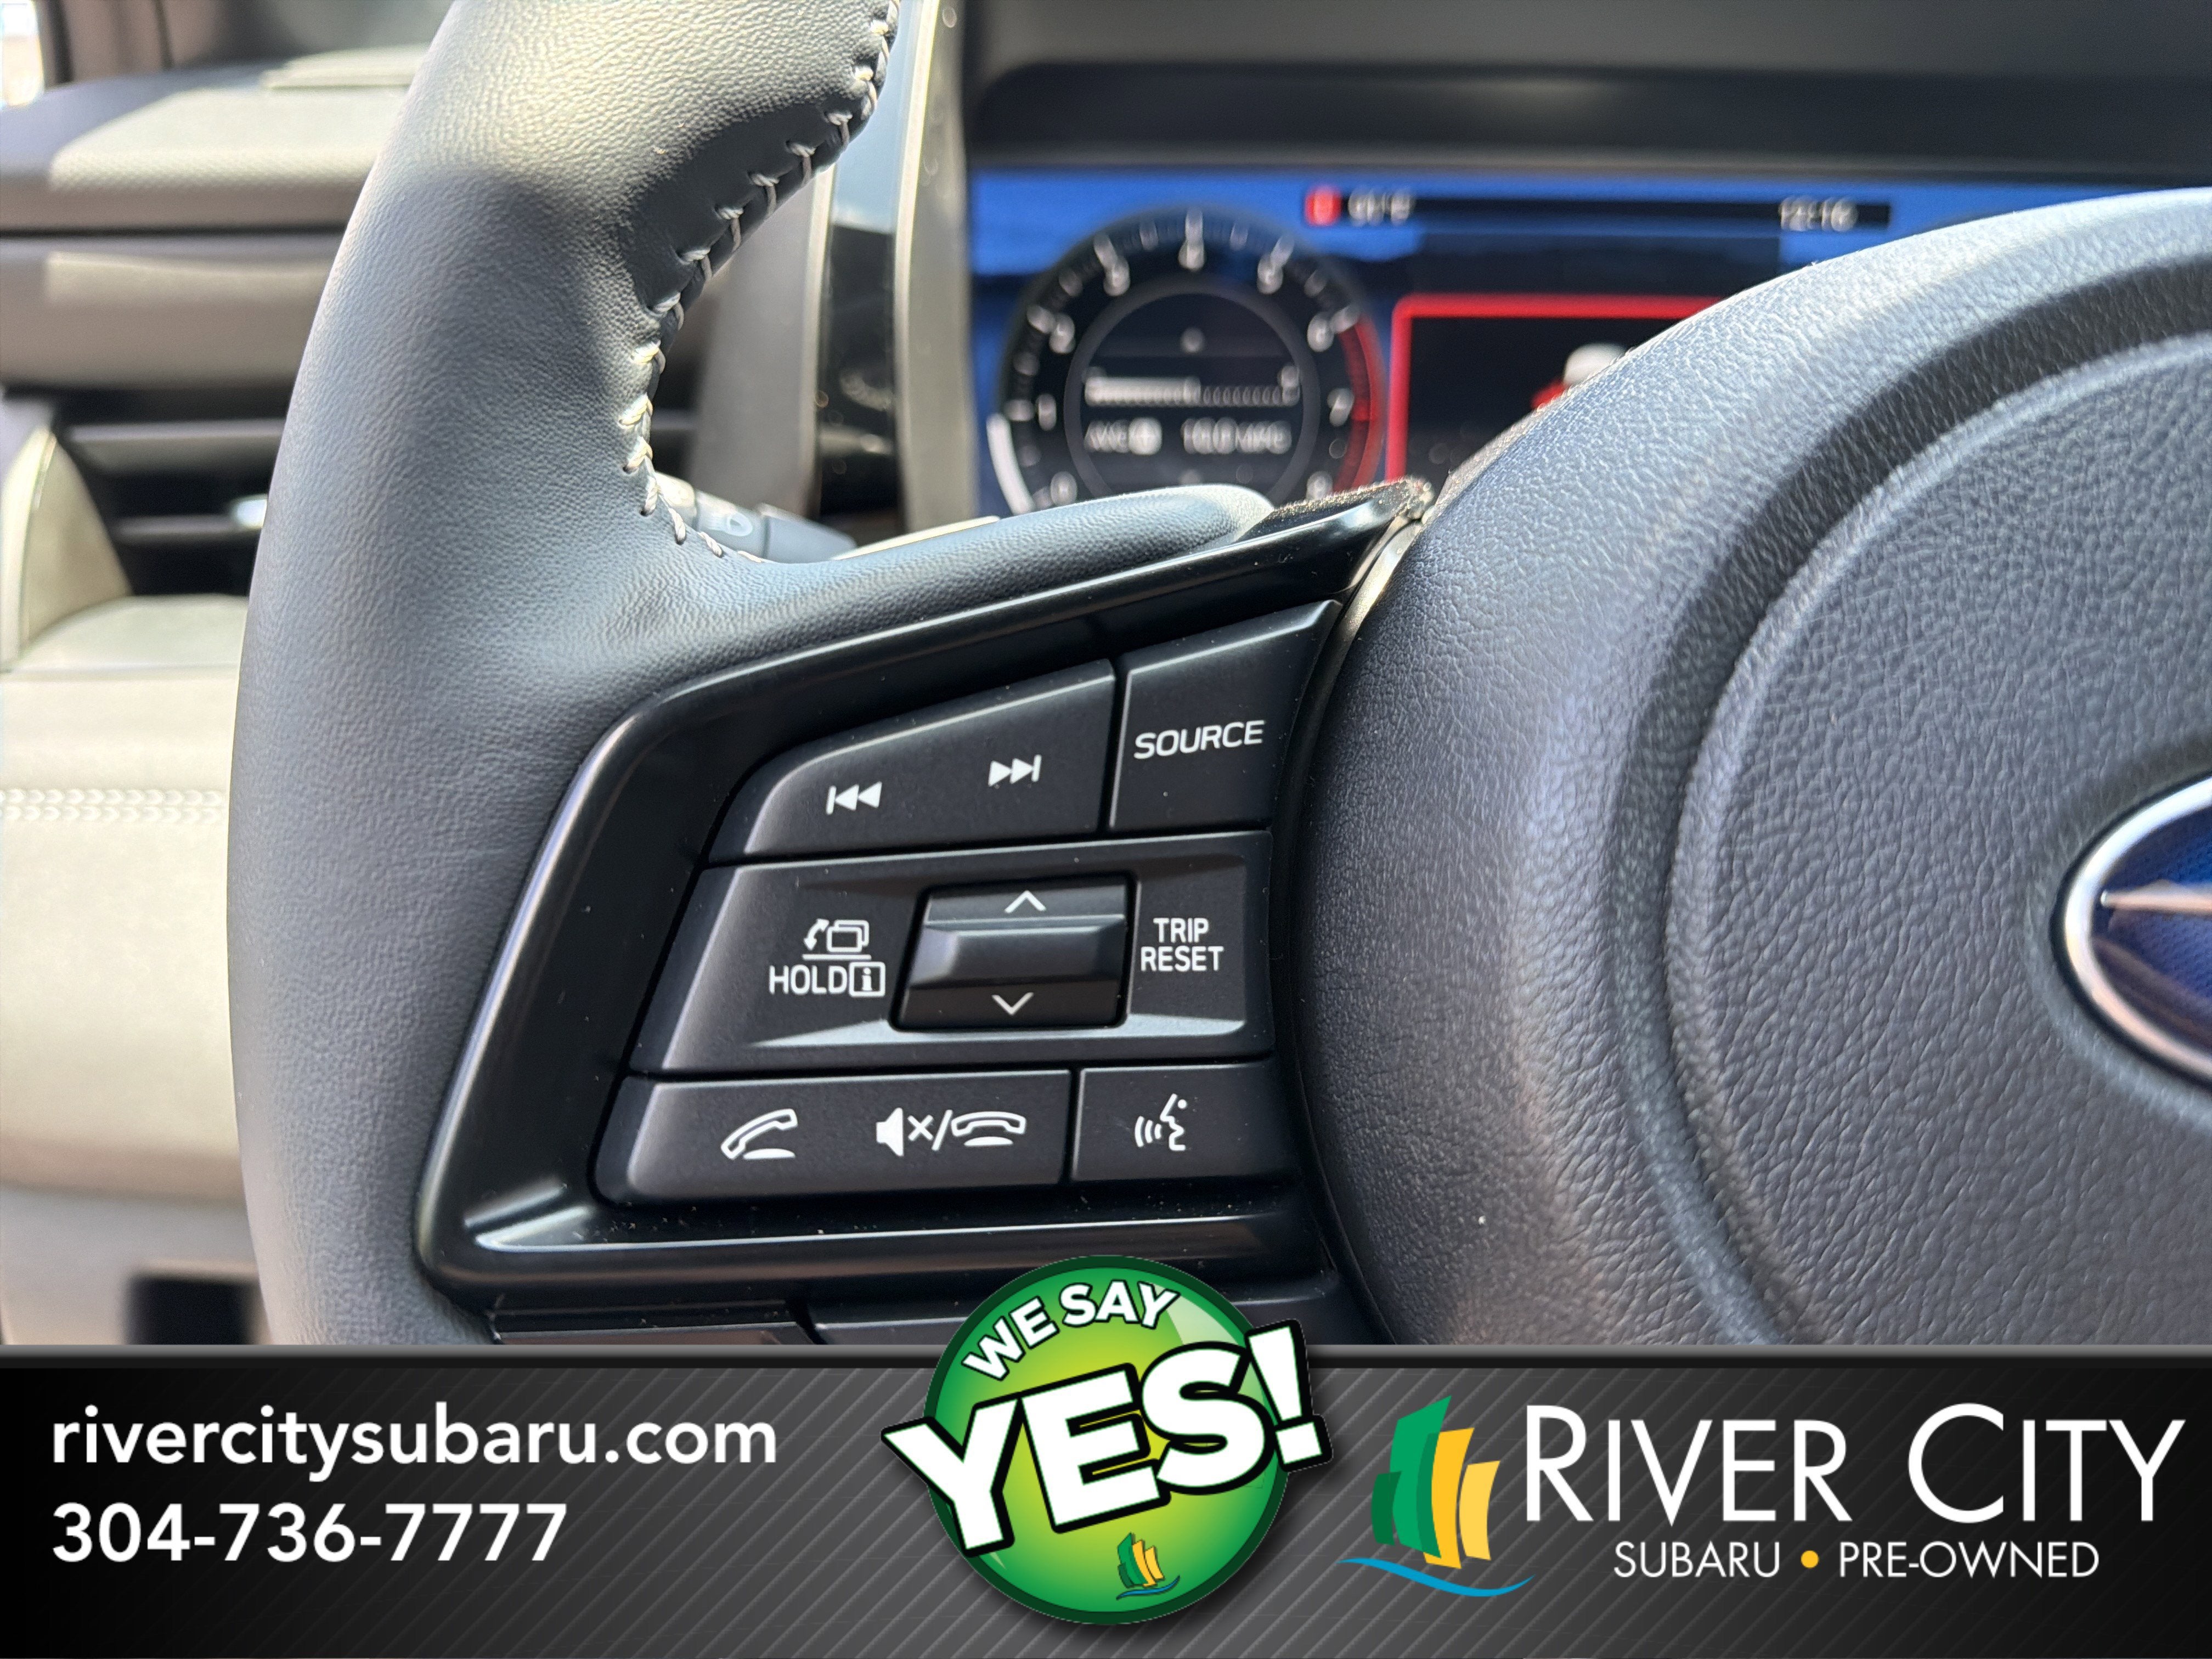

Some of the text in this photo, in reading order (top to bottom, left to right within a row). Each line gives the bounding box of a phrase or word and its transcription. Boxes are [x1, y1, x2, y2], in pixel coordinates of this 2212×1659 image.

[1133, 720, 1265, 759] SOURCE
[1153, 917, 1209, 943] TRIP
[1141, 945, 1224, 972] RESET
[769, 964, 848, 995] HOLD
